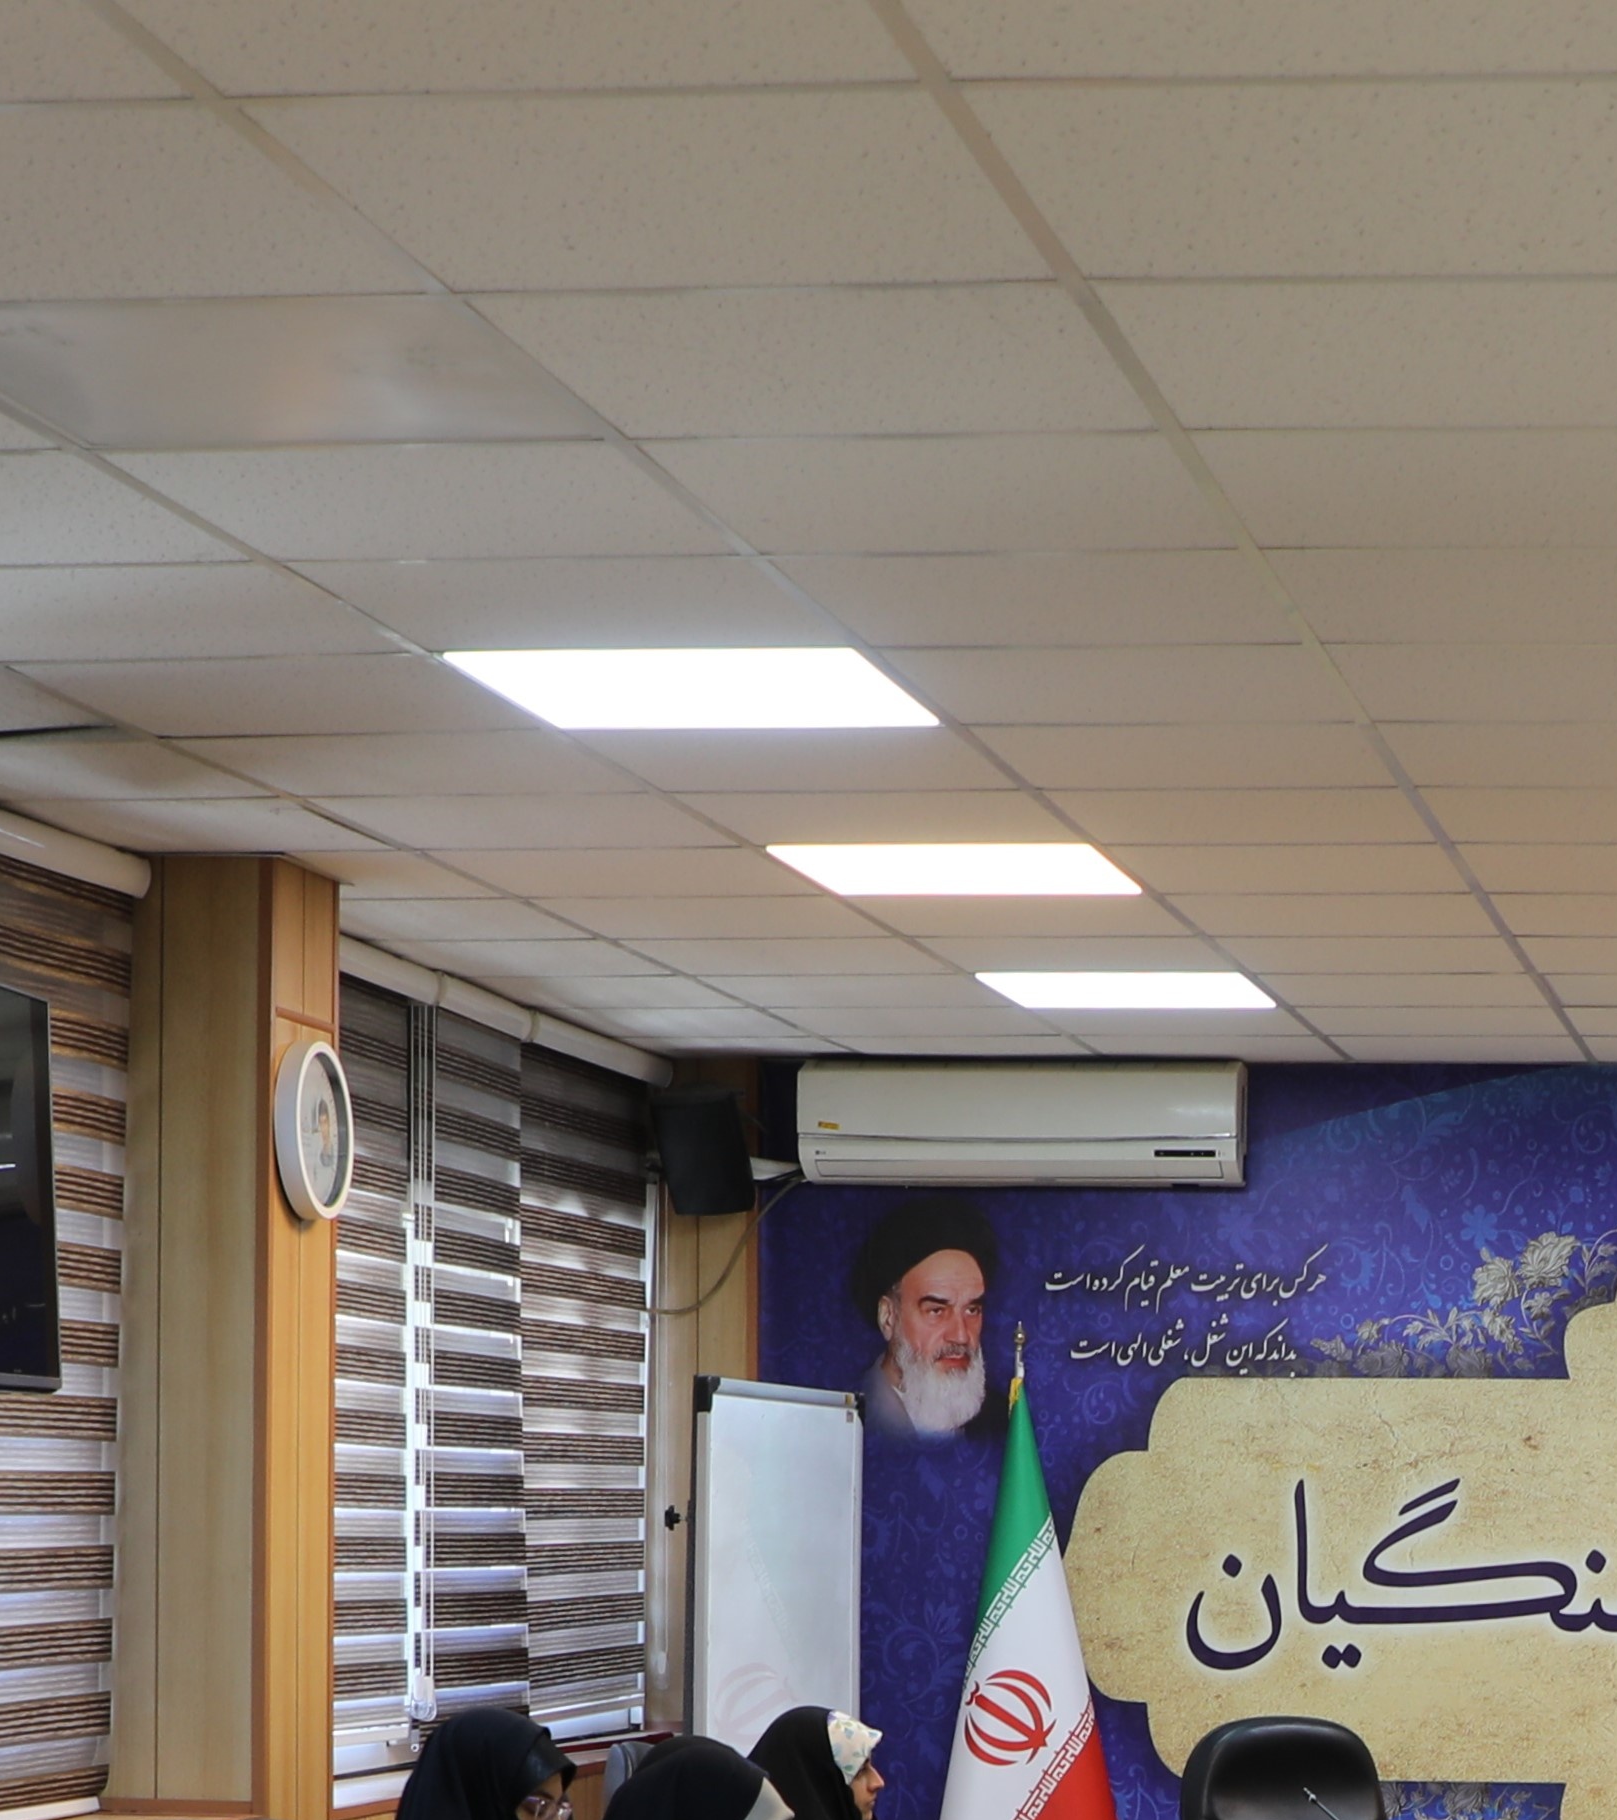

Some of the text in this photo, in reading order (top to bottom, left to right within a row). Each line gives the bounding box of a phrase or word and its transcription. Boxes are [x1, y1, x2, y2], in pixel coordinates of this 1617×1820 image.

[1124, 1260, 1159, 1312] قیام
[1155, 1264, 1190, 1314] معلم
[1190, 1263, 1245, 1302] تربیت
[1240, 1272, 1280, 1306] برای
[1069, 1339, 1117, 1360] است
[1116, 1332, 1148, 1367] الهی
[1147, 1318, 1185, 1367] شغلی
[1224, 1341, 1254, 1375] این
